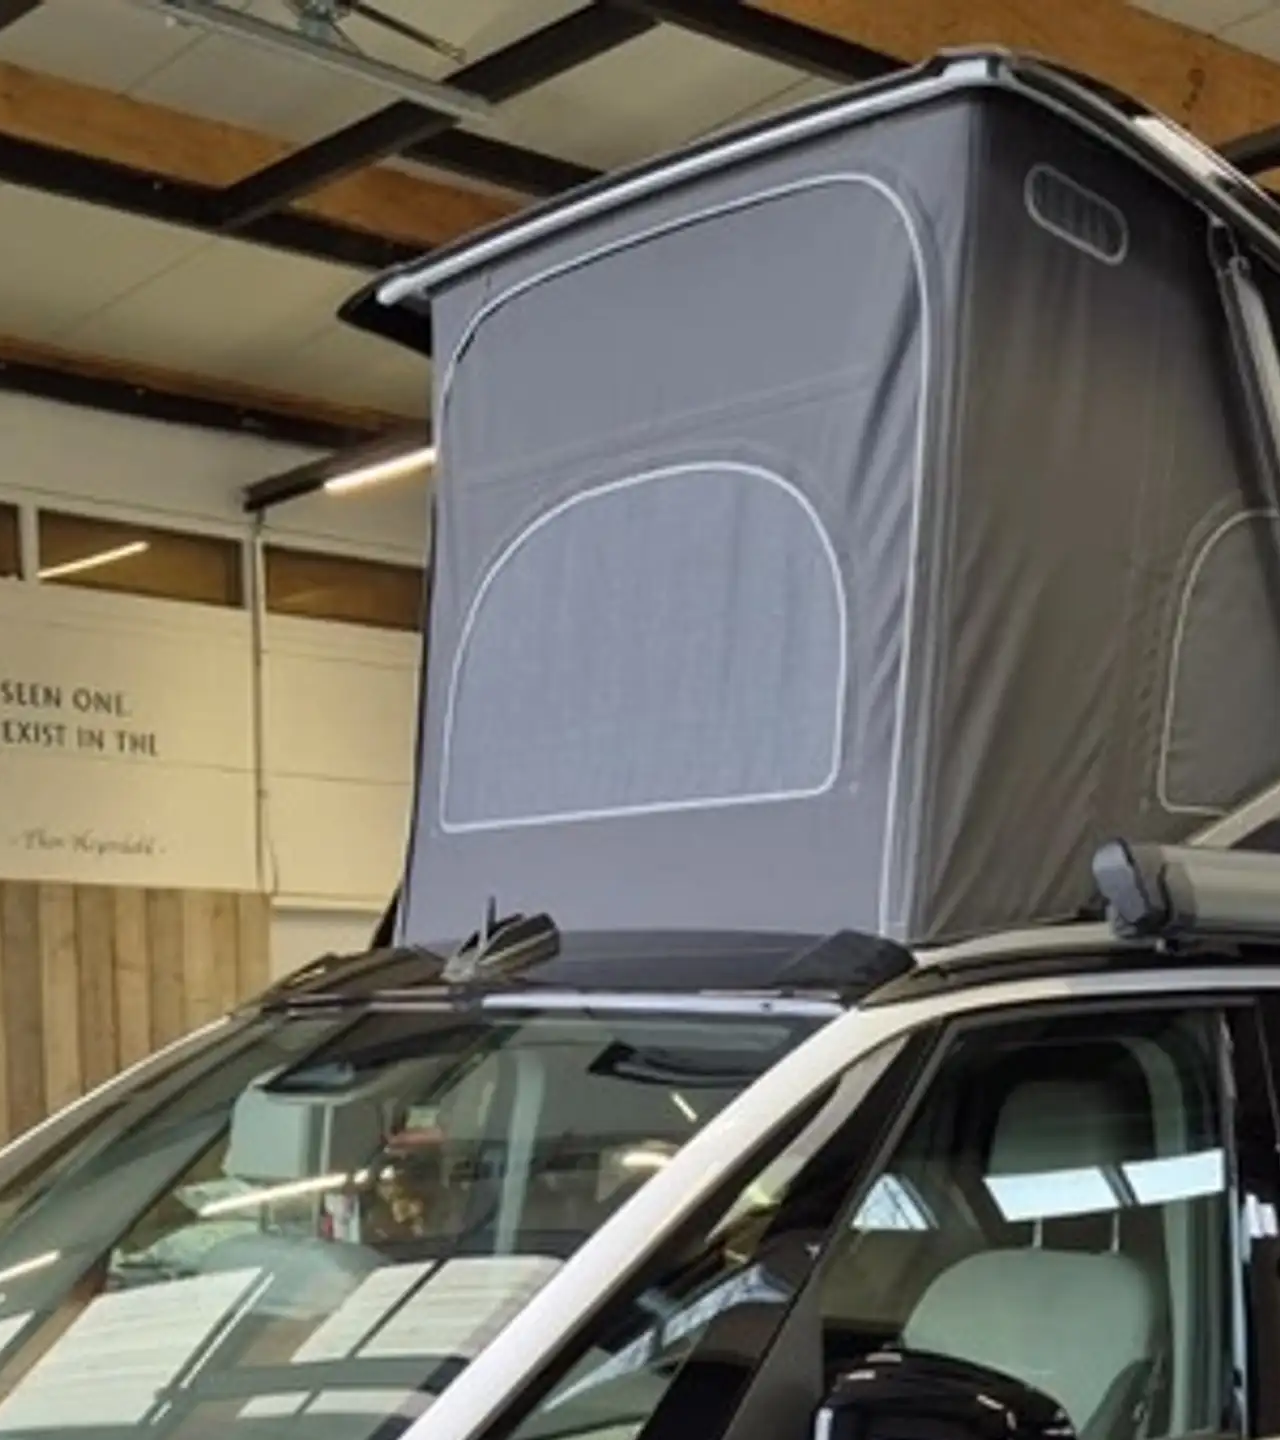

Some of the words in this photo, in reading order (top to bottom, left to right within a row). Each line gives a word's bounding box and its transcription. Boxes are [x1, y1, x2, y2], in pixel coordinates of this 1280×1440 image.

[0, 678, 63, 708] SEEN
[1, 720, 68, 748] EXIST
[76, 726, 105, 752] IN
[114, 730, 159, 757] THE
